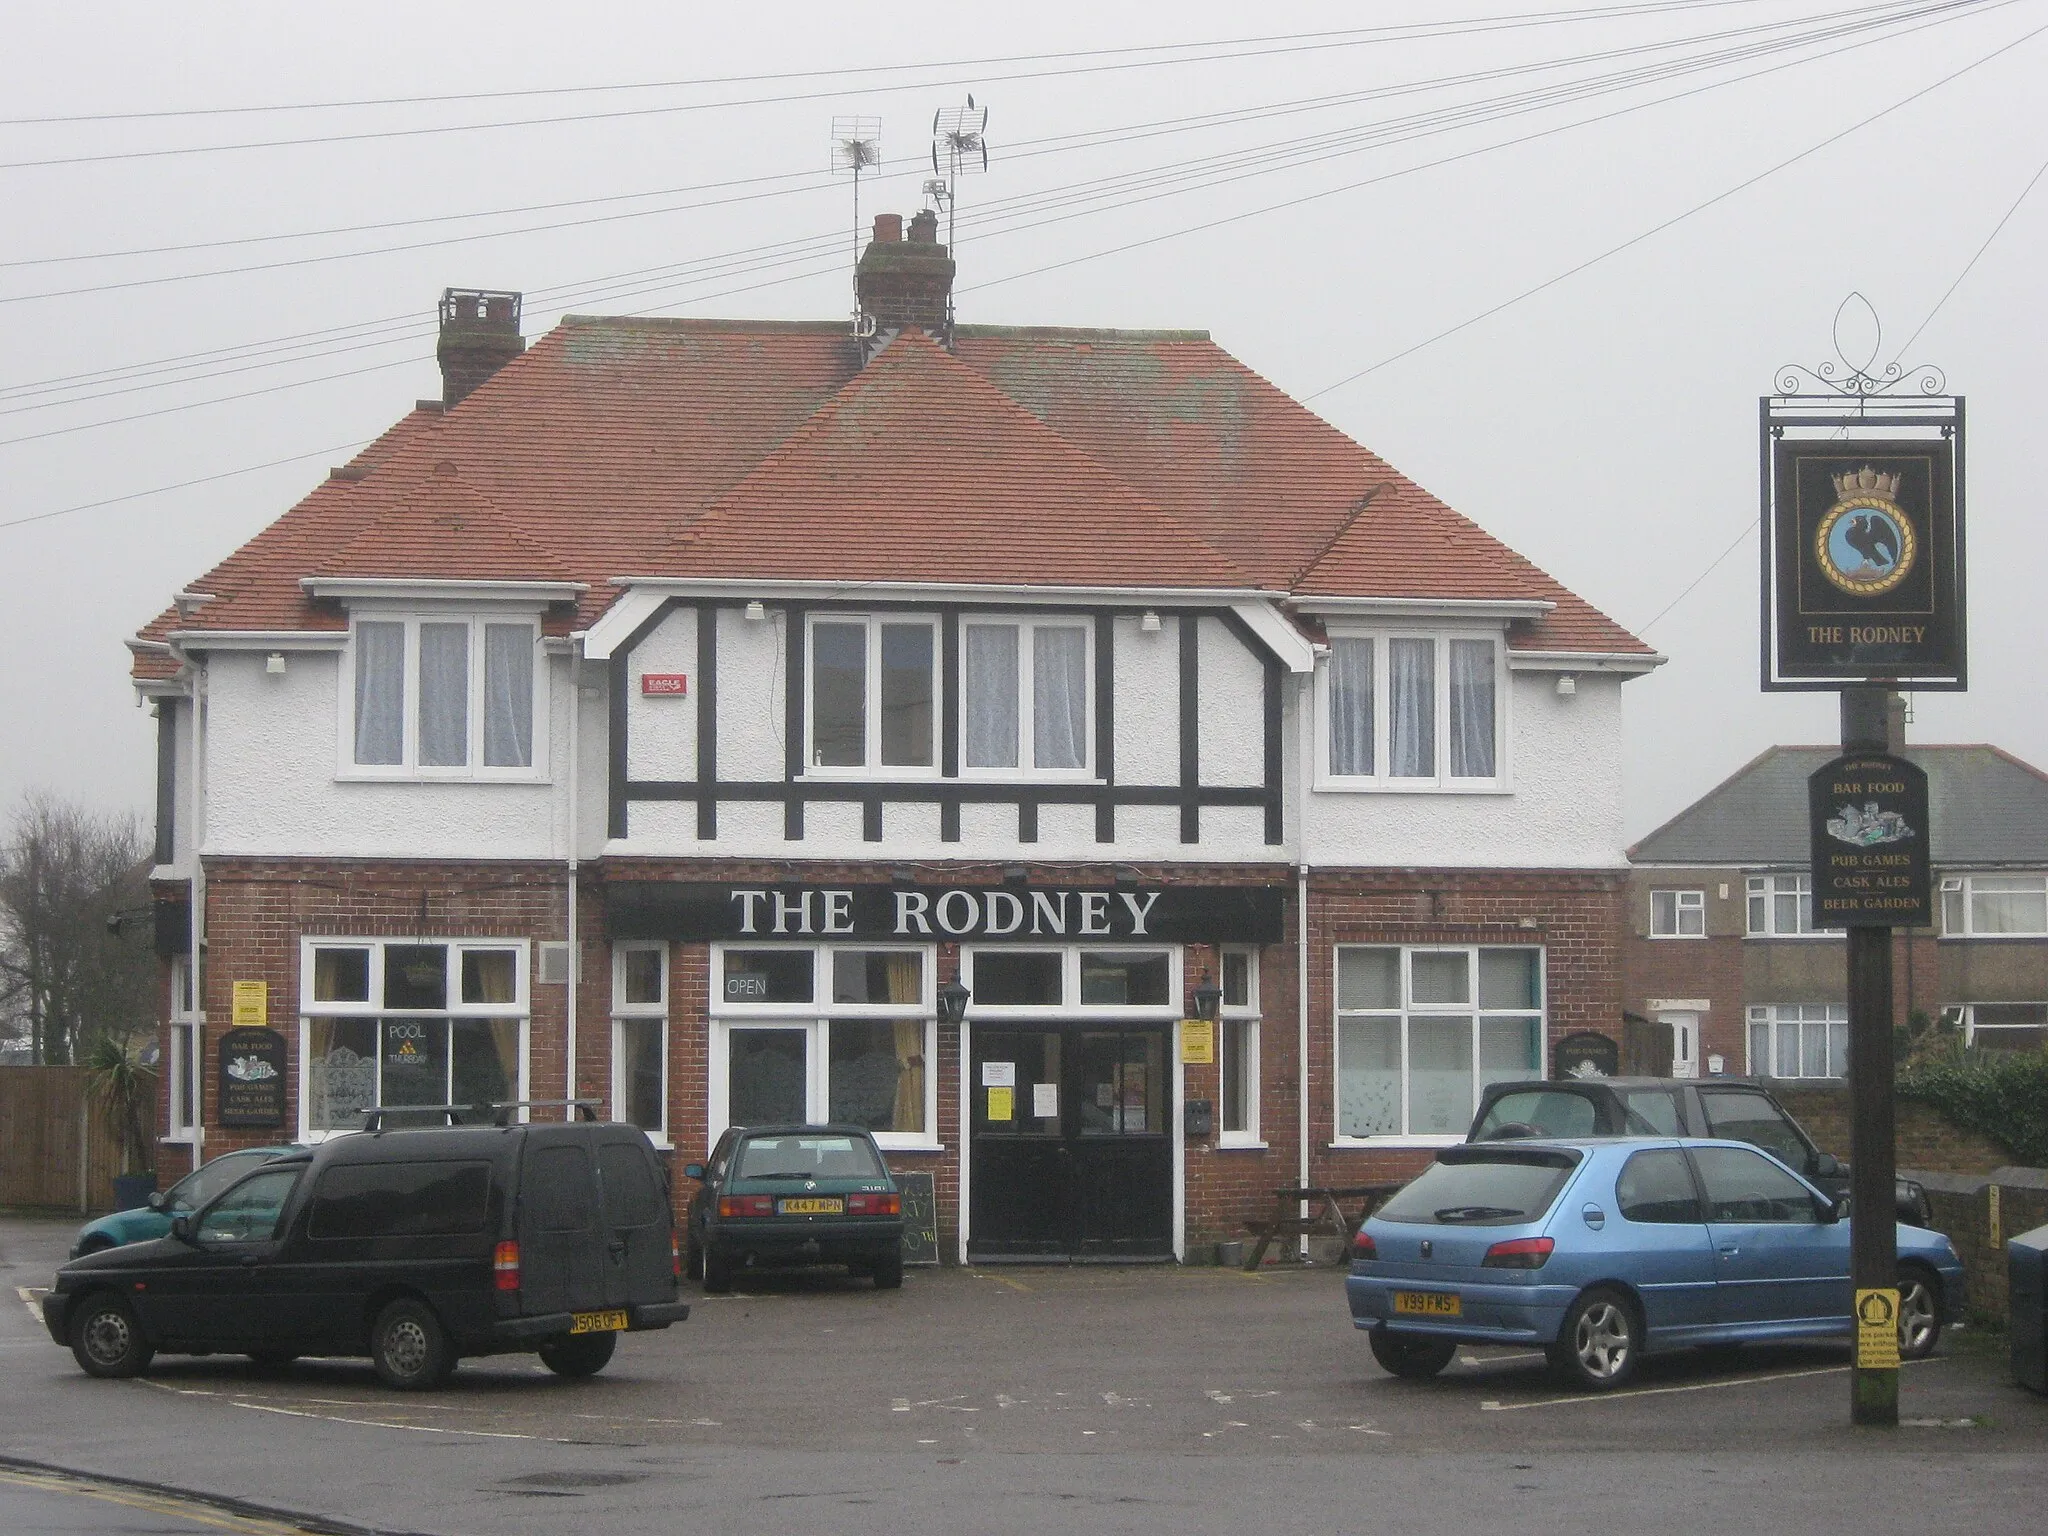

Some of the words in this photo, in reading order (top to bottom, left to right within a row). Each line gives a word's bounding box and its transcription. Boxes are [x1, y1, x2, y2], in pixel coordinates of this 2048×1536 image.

[1808, 626, 1843, 643] THE
[1850, 626, 1925, 643] RODNEY
[1833, 782, 1862, 793] BAR
[1868, 782, 1904, 793] FOOD
[1831, 855, 1858, 865] PUB
[1863, 855, 1911, 865] GAMES
[1833, 876, 1870, 887] CASK
[1875, 876, 1911, 887] ALES
[1824, 898, 1858, 910] BEER
[1864, 898, 1920, 909] GARDEN
[731, 890, 855, 934] THE
[893, 890, 1161, 935] RODNEY
[727, 978, 766, 995] OPEN
[389, 1025, 427, 1039] POOL
[785, 1201, 816, 1211] K447
[1403, 1294, 1425, 1311] V99
[1427, 1295, 1451, 1312] FMS
